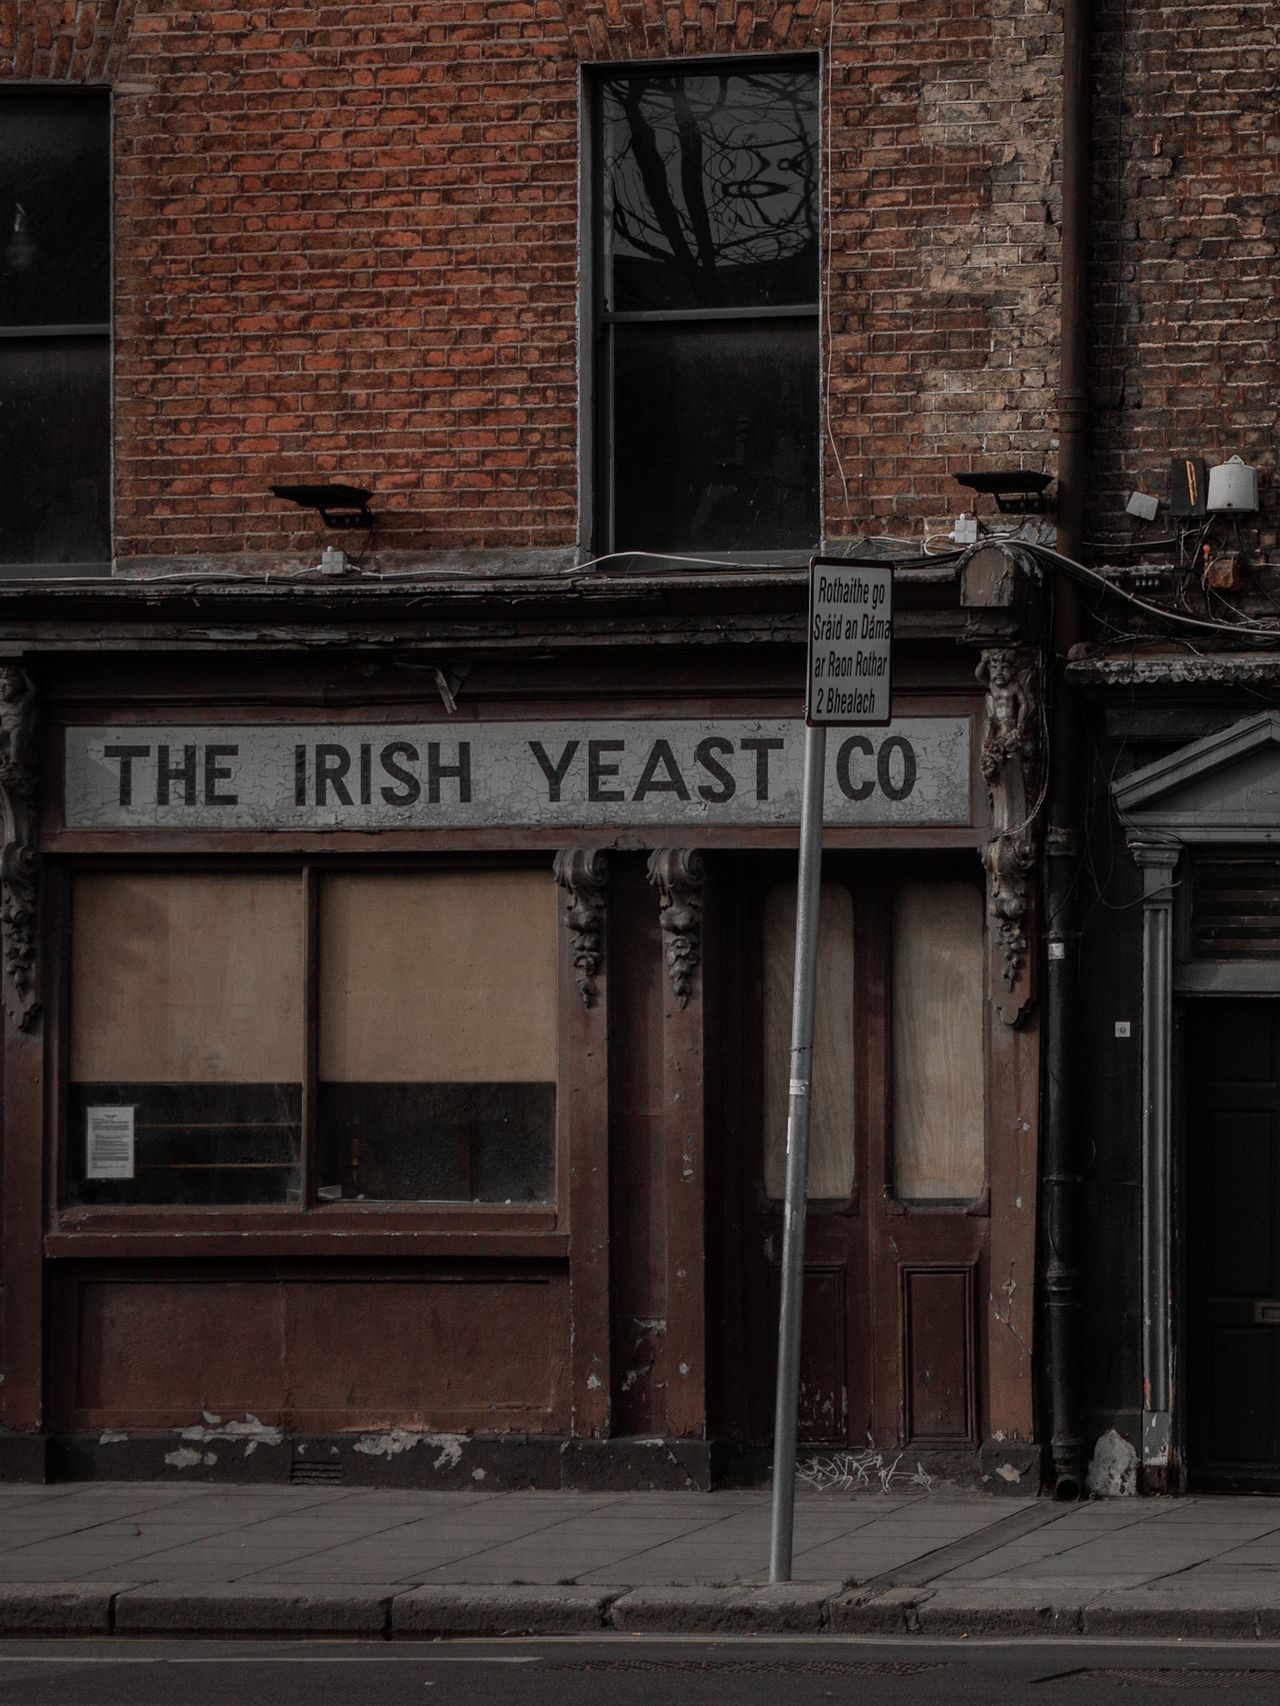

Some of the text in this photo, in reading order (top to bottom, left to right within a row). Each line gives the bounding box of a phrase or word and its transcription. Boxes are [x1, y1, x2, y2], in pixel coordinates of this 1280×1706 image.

[818, 576, 885, 610] Rothaithe go
[813, 613, 891, 641] Sráid an Dáma
[814, 651, 888, 677] ar Raon Rothar
[816, 687, 876, 714] 2 Bhealach
[104, 734, 916, 807] THE IRISH YEAST CO
